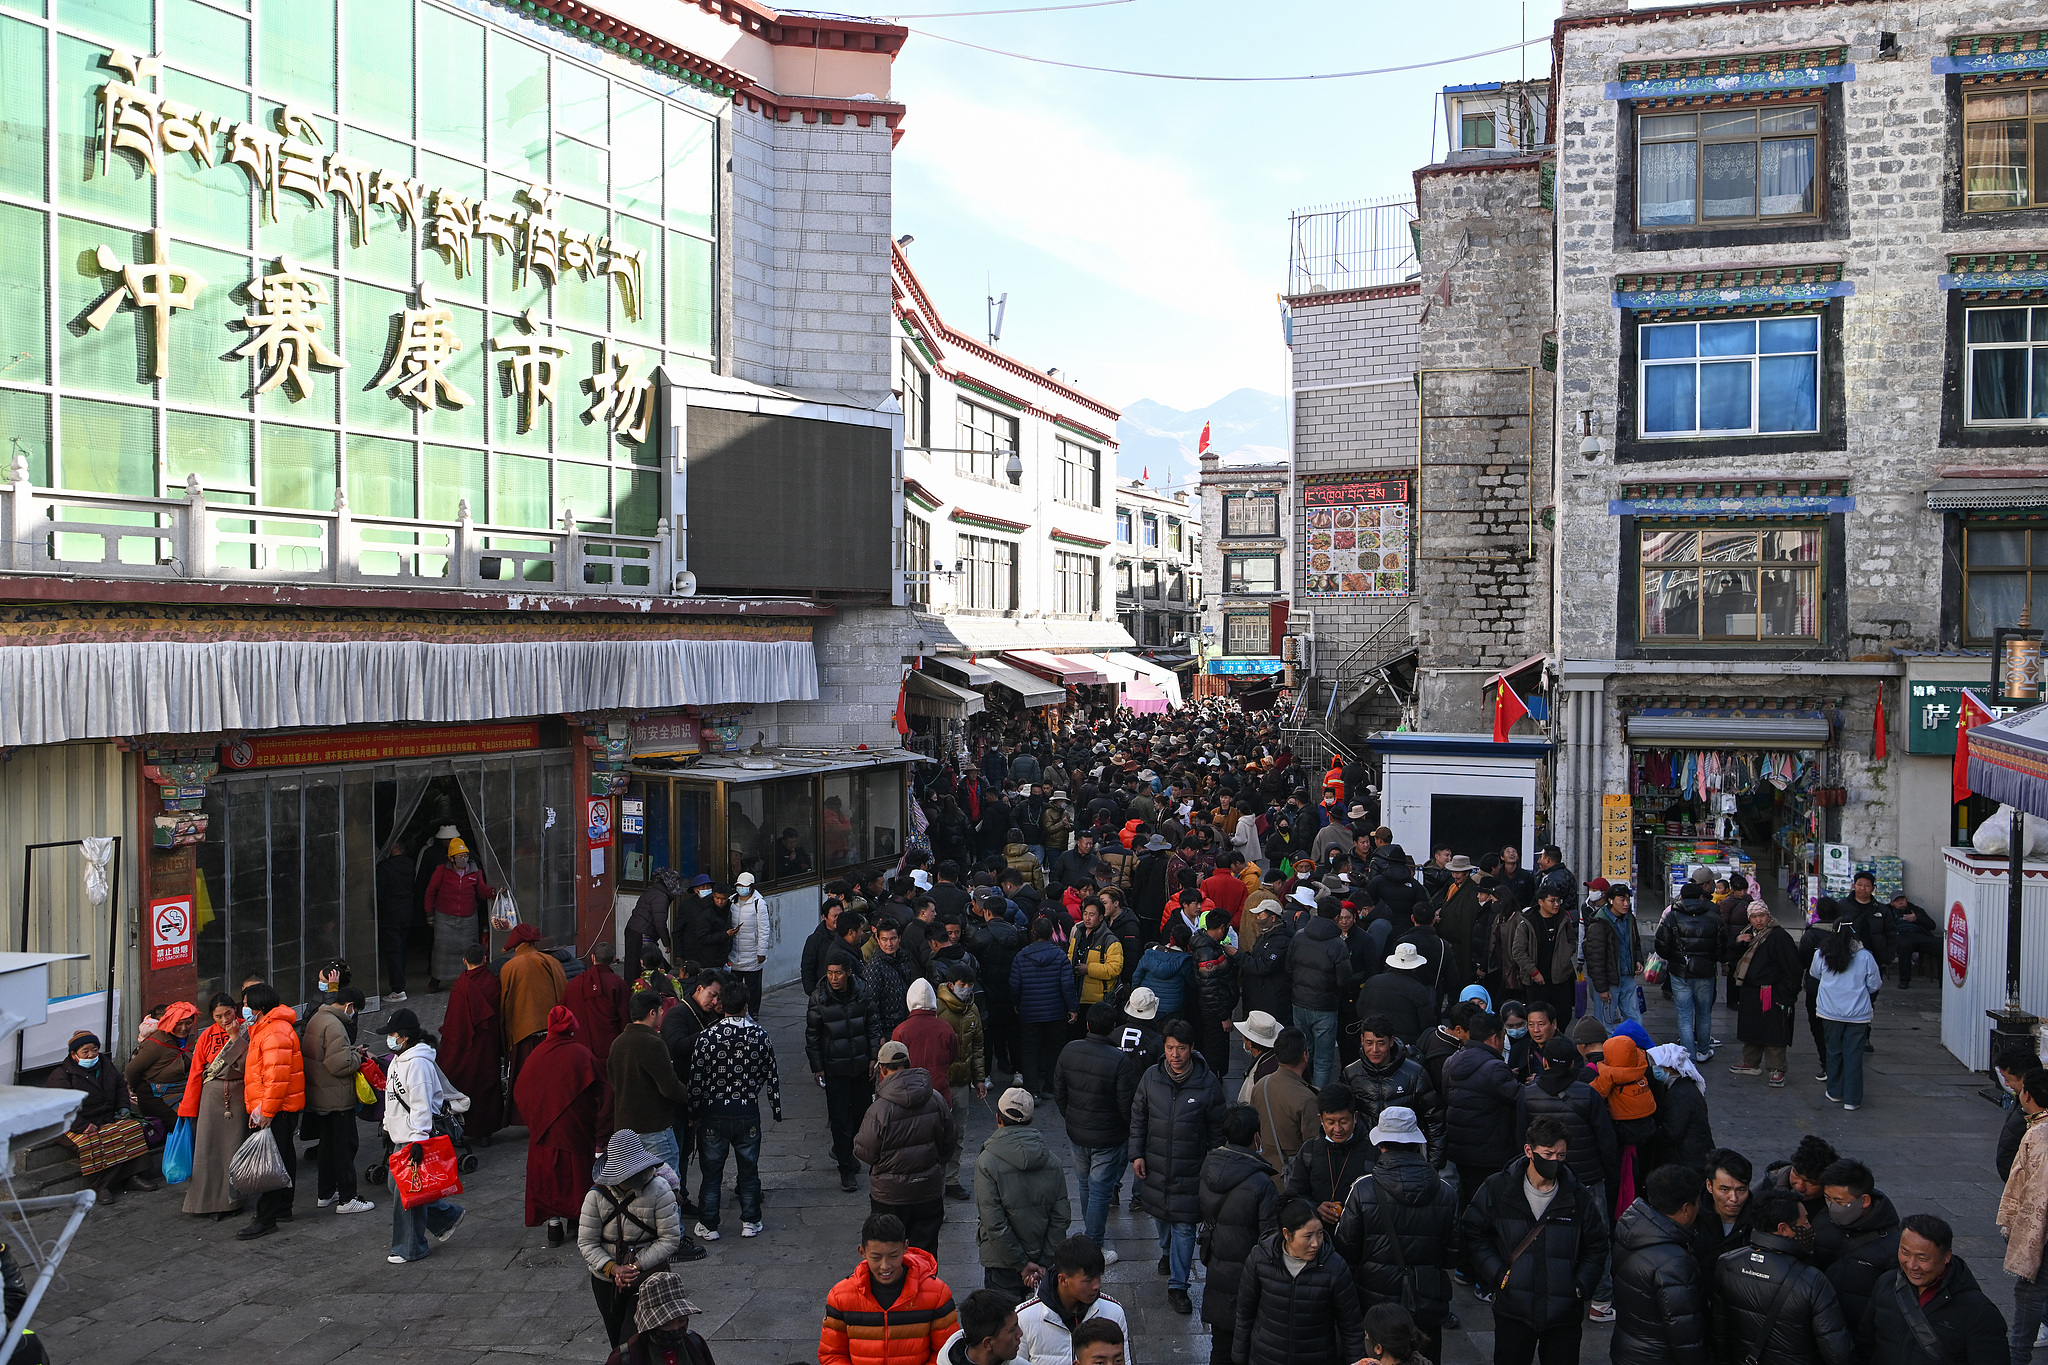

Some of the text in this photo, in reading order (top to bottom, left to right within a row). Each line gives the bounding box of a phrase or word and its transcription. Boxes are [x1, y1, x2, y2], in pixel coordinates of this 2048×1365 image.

[86, 228, 656, 443] 冲赛康市场
[1913, 685, 1937, 697] 清真
[157, 945, 189, 957] 禁止吸烟
[165, 953, 188, 961] SMOKING
